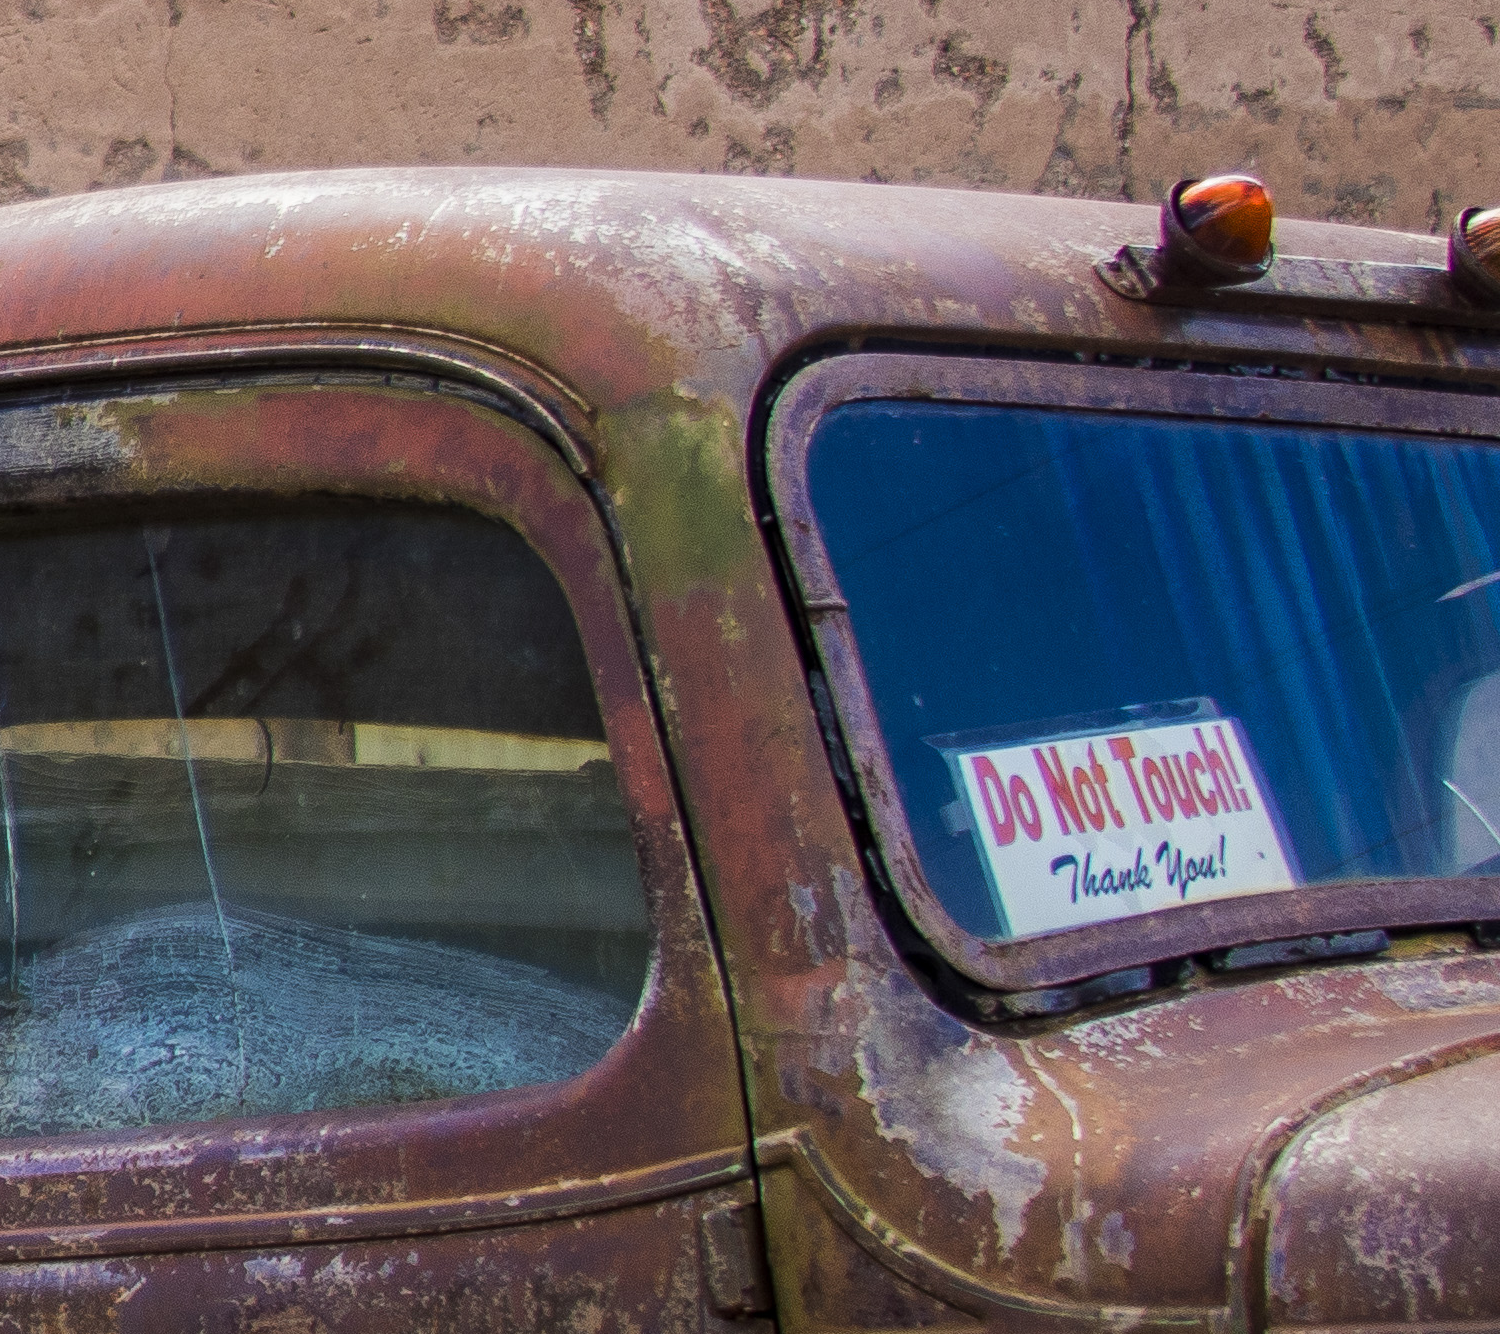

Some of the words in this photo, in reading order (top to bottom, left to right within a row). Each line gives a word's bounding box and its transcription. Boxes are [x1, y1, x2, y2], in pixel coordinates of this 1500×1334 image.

[971, 756, 1041, 847] Do
[1032, 742, 1124, 836] Not
[1107, 725, 1252, 825] Touch!
[1051, 847, 1151, 903] Thank
[1155, 835, 1226, 899] You!
